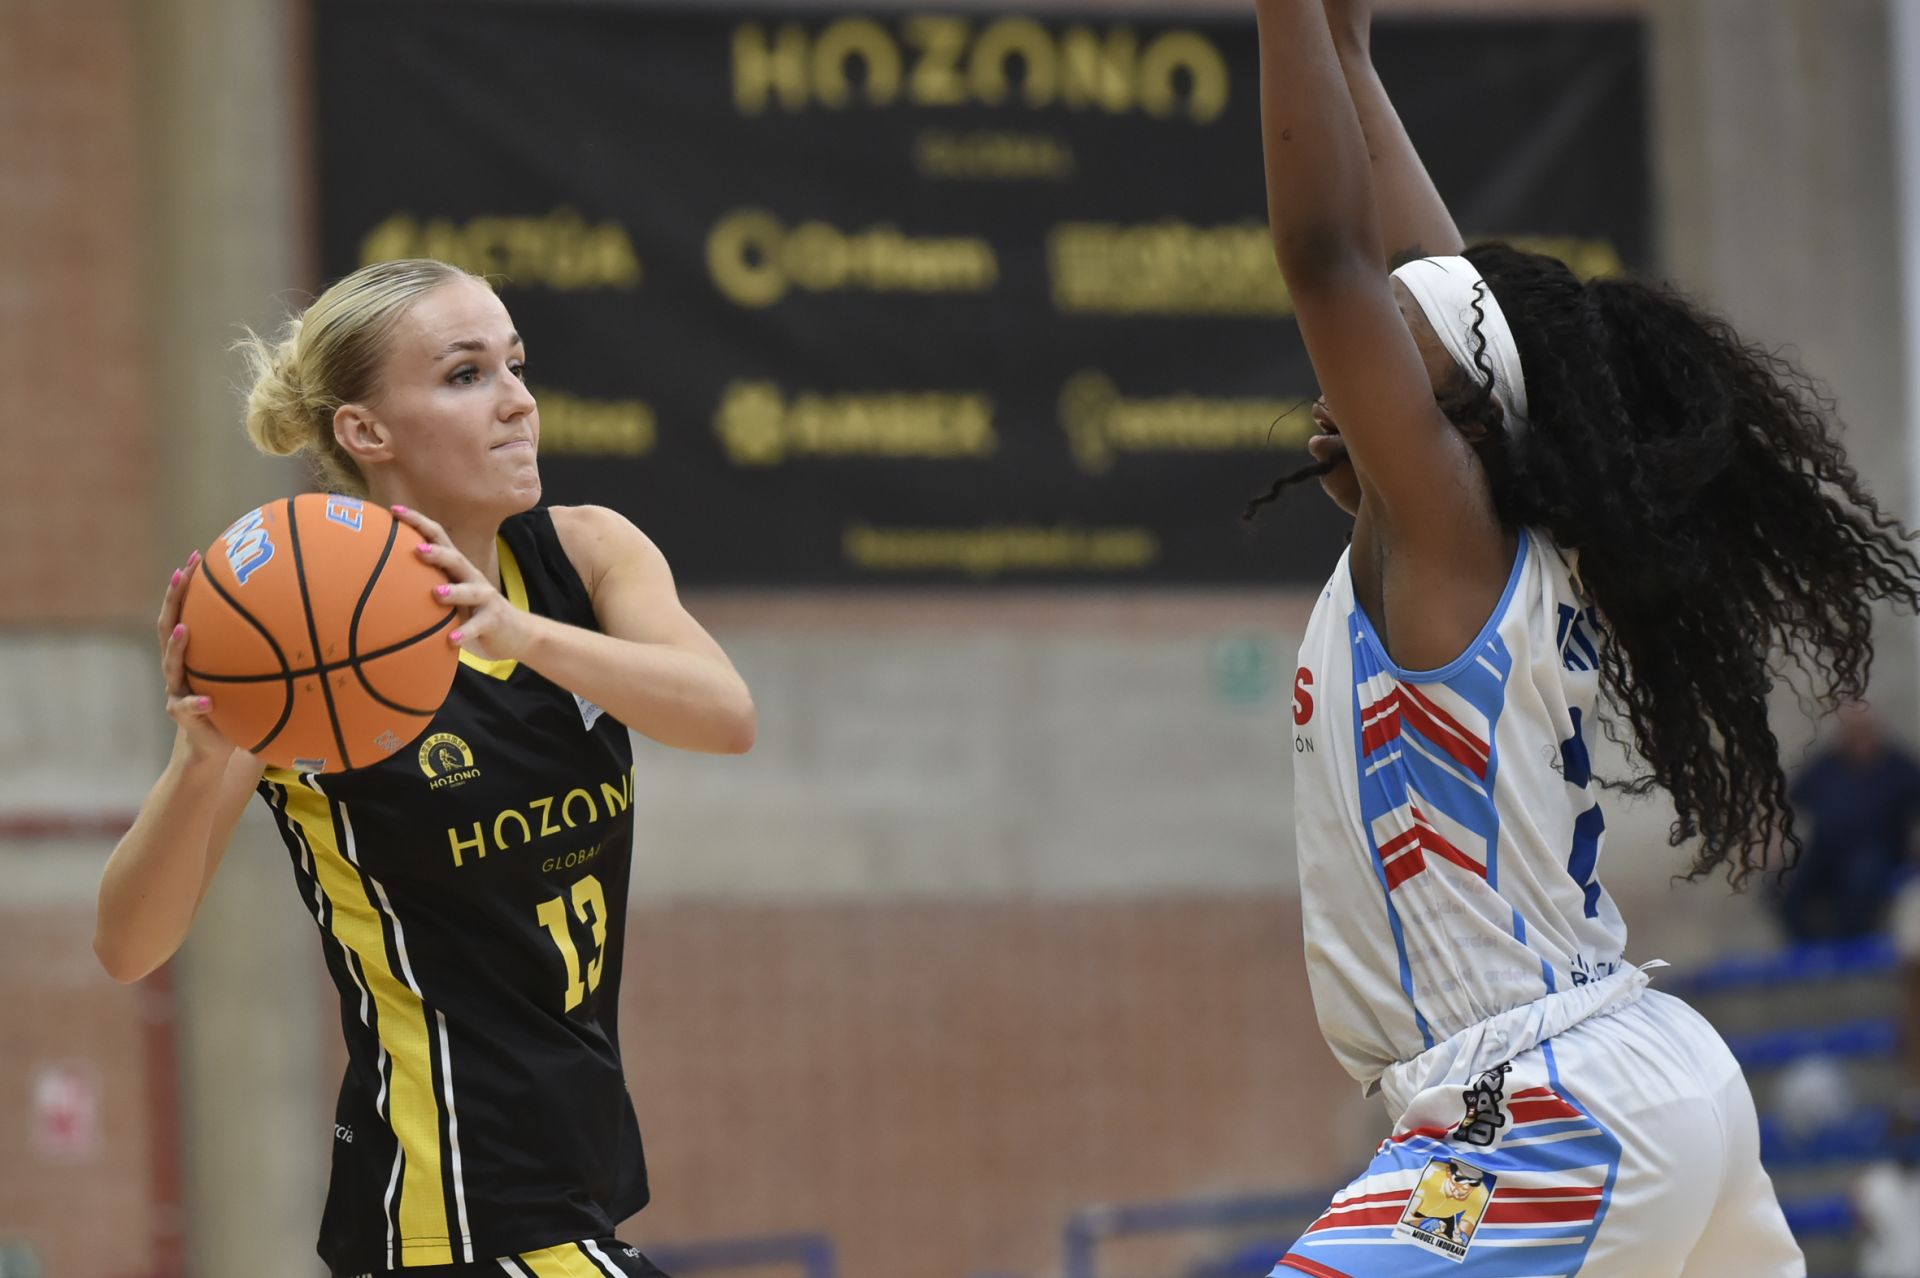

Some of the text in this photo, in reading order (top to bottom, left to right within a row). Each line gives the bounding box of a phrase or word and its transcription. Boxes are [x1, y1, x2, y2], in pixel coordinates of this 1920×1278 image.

[731, 17, 1229, 122] HOZONO
[429, 768, 481, 790] HOZONO
[536, 874, 608, 1014] 13
[1412, 1229, 1435, 1245] MIGUEL
[1436, 1238, 1466, 1257] INDURAIN
